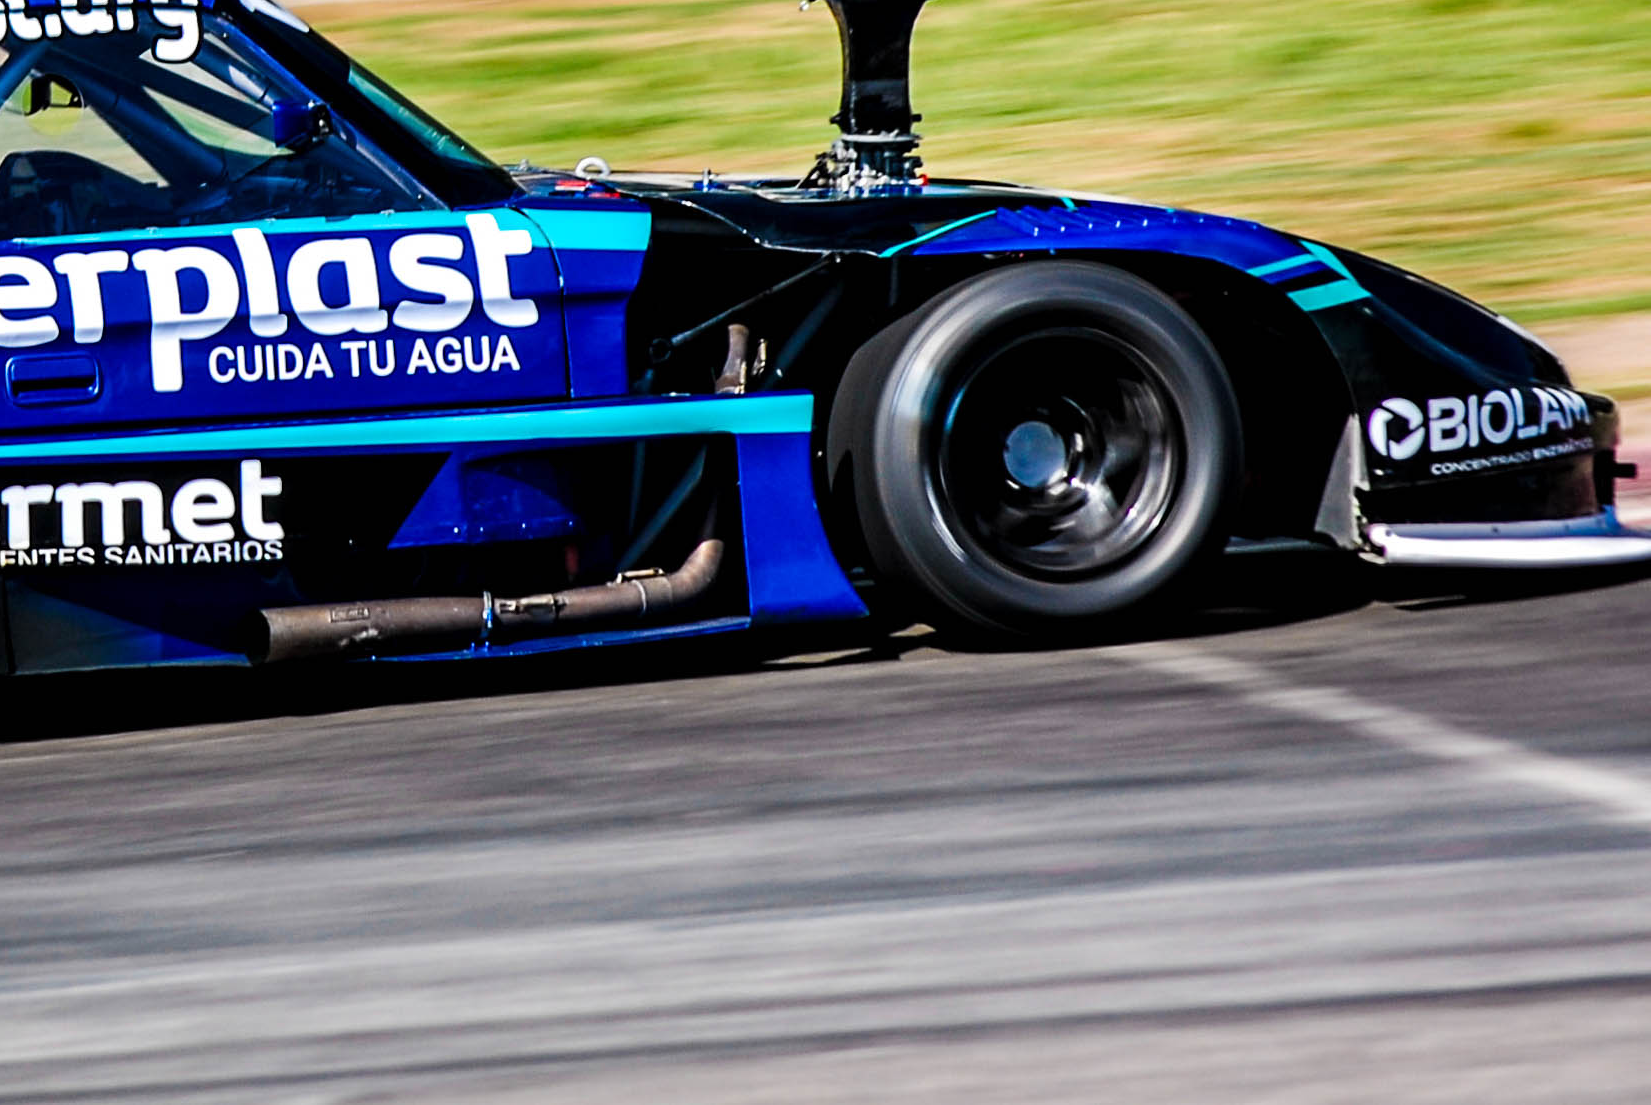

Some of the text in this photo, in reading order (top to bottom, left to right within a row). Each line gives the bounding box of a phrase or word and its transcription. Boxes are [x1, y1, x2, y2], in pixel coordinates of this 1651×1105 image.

[208, 335, 521, 383] CUIDA TU AGUA
[1427, 388, 1591, 452] BIOLAM
[104, 540, 284, 565] SANITARIOS
